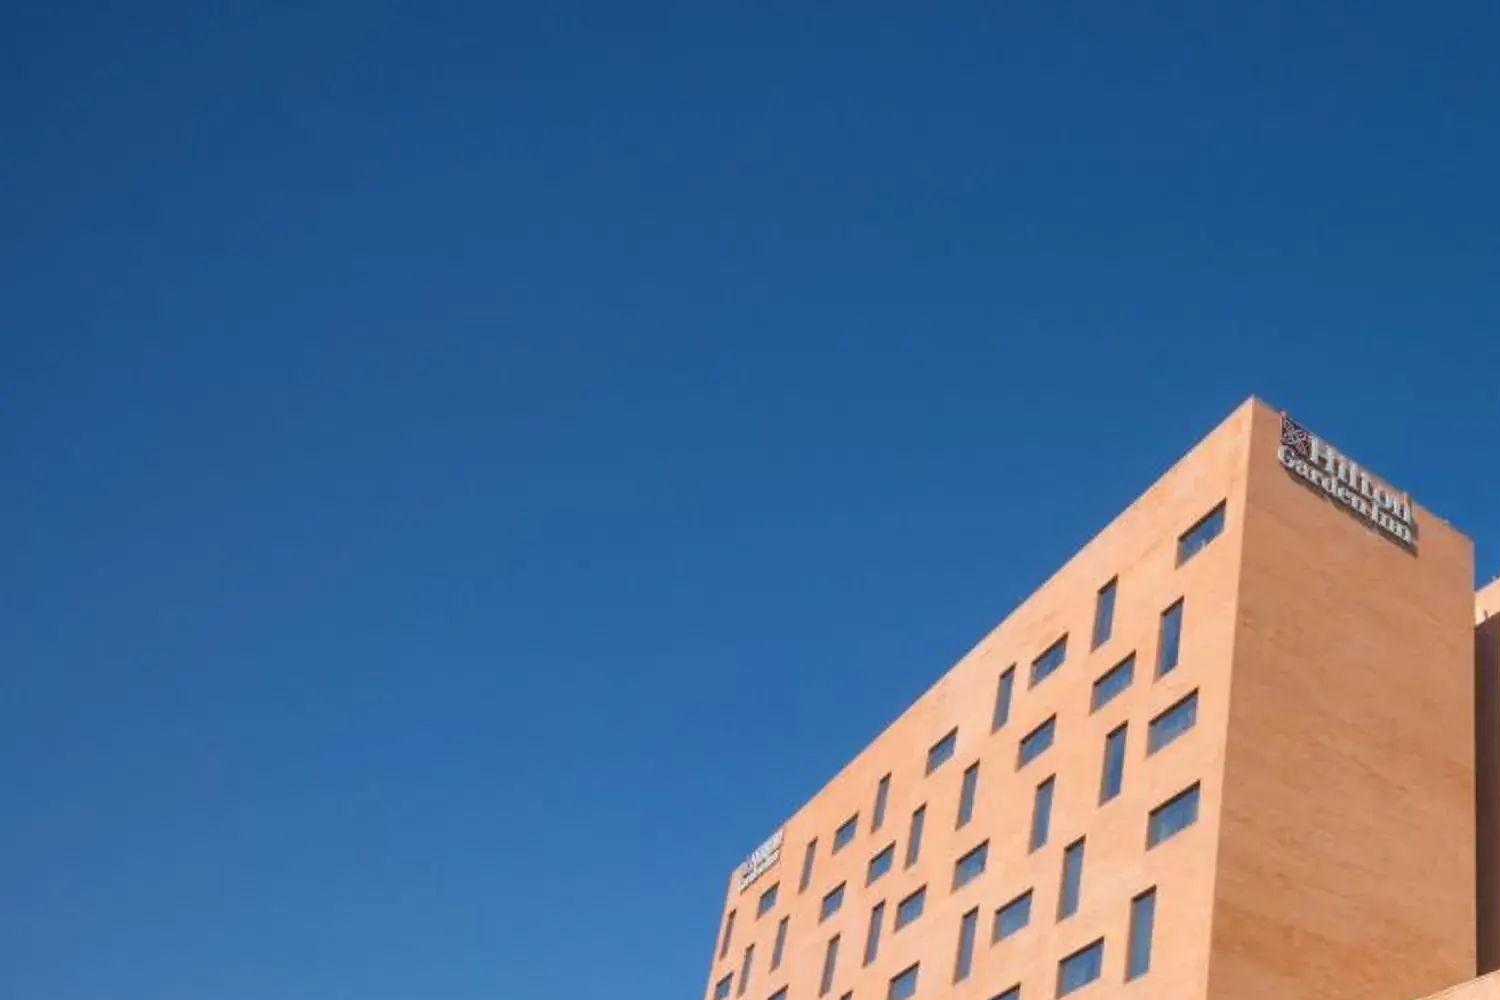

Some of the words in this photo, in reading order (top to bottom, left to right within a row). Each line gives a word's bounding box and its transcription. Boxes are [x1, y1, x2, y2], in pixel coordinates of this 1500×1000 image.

[1277, 445, 1368, 515] Garden
[1370, 501, 1413, 544] Inn
[1309, 434, 1413, 525] Hilton
